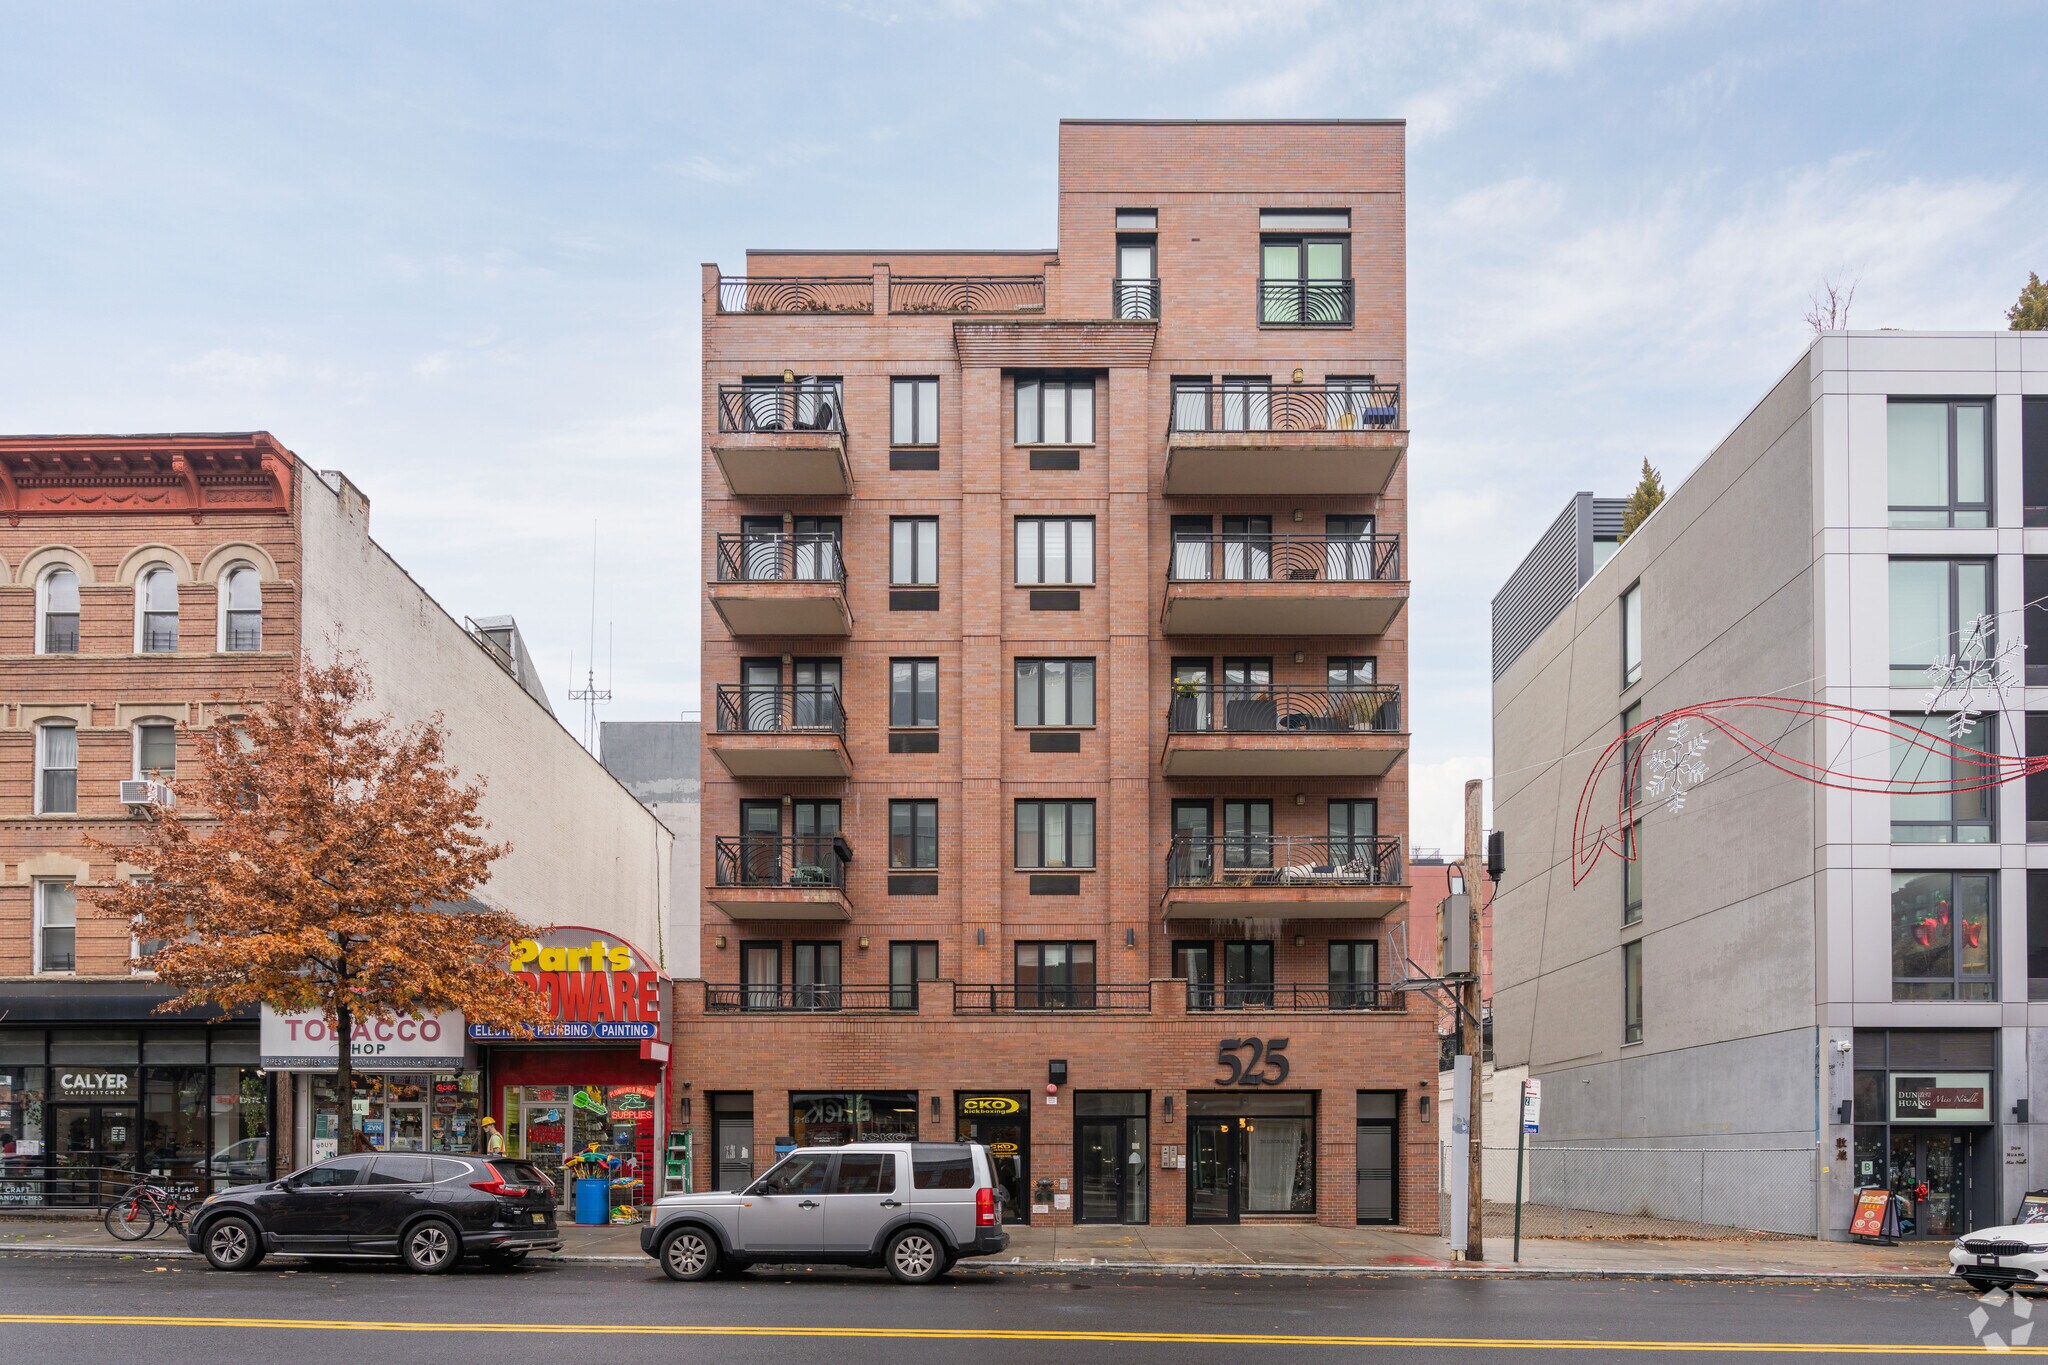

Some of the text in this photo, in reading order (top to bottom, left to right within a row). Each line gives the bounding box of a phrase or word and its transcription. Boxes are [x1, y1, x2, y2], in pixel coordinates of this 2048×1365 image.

[510, 939, 633, 971] Parts
[602, 1025, 648, 1036] PAINTING
[352, 1044, 385, 1054] HOP
[287, 1058, 321, 1066] CIGARETTES
[1215, 1037, 1289, 1085] 525
[61, 1073, 128, 1089] CALYER
[1898, 1091, 1918, 1099] DUN
[964, 1100, 1006, 1109] CKO
[611, 1110, 653, 1119] SUPPLIES
[1864, 1162, 1871, 1171] B
